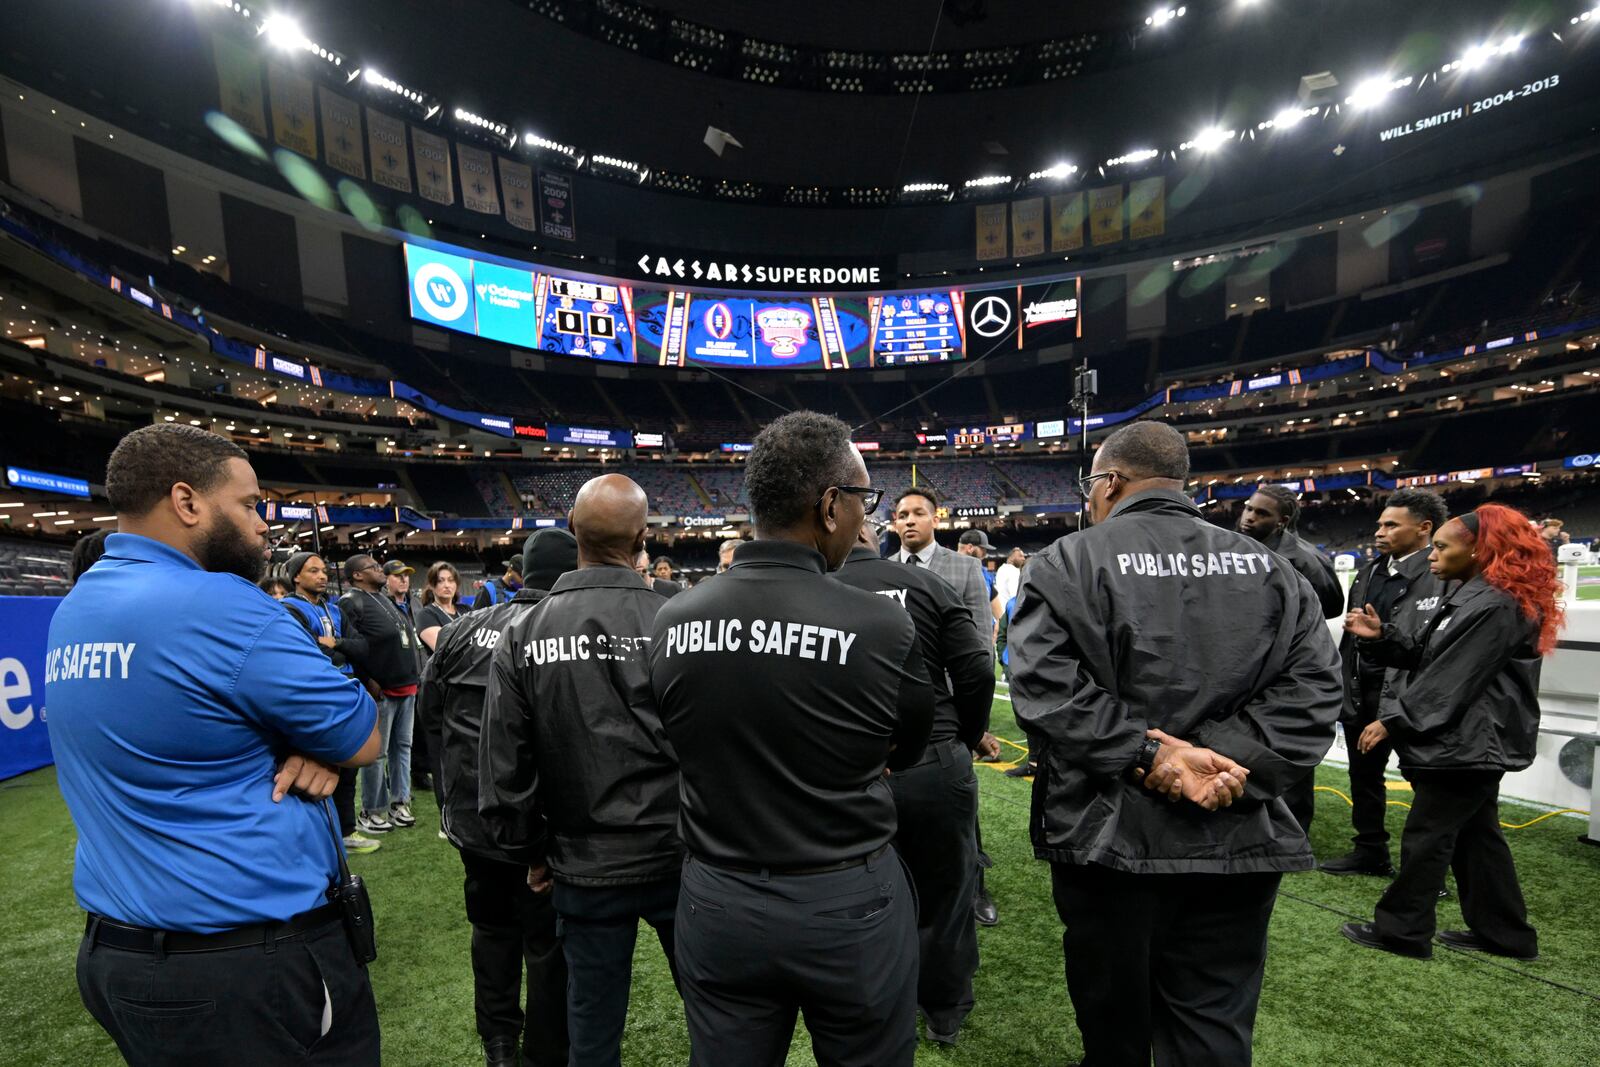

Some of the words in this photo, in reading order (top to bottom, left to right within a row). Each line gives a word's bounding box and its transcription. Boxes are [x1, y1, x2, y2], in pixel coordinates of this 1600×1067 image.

[1380, 124, 1413, 142] WILL
[1415, 107, 1462, 132] SMITH
[1472, 75, 1560, 114] 2004-2013
[544, 186, 568, 199] 2009
[637, 254, 753, 283] CAESARS
[755, 266, 880, 284] SUPERDOME
[566, 313, 575, 329] 0
[597, 318, 606, 333] 0
[515, 426, 546, 437] verizon
[20, 474, 56, 487] HANCOCK
[56, 481, 89, 493] WHITNEY
[684, 516, 725, 526] Ochsner
[957, 507, 995, 516] CAESARS
[1116, 553, 1188, 577] PUBLIC
[1191, 552, 1271, 578] SAFETY
[524, 634, 590, 668] PUBLIC
[665, 618, 743, 658] PUBLIC
[749, 619, 857, 665] SAFETY
[61, 642, 136, 680] SAFETY
